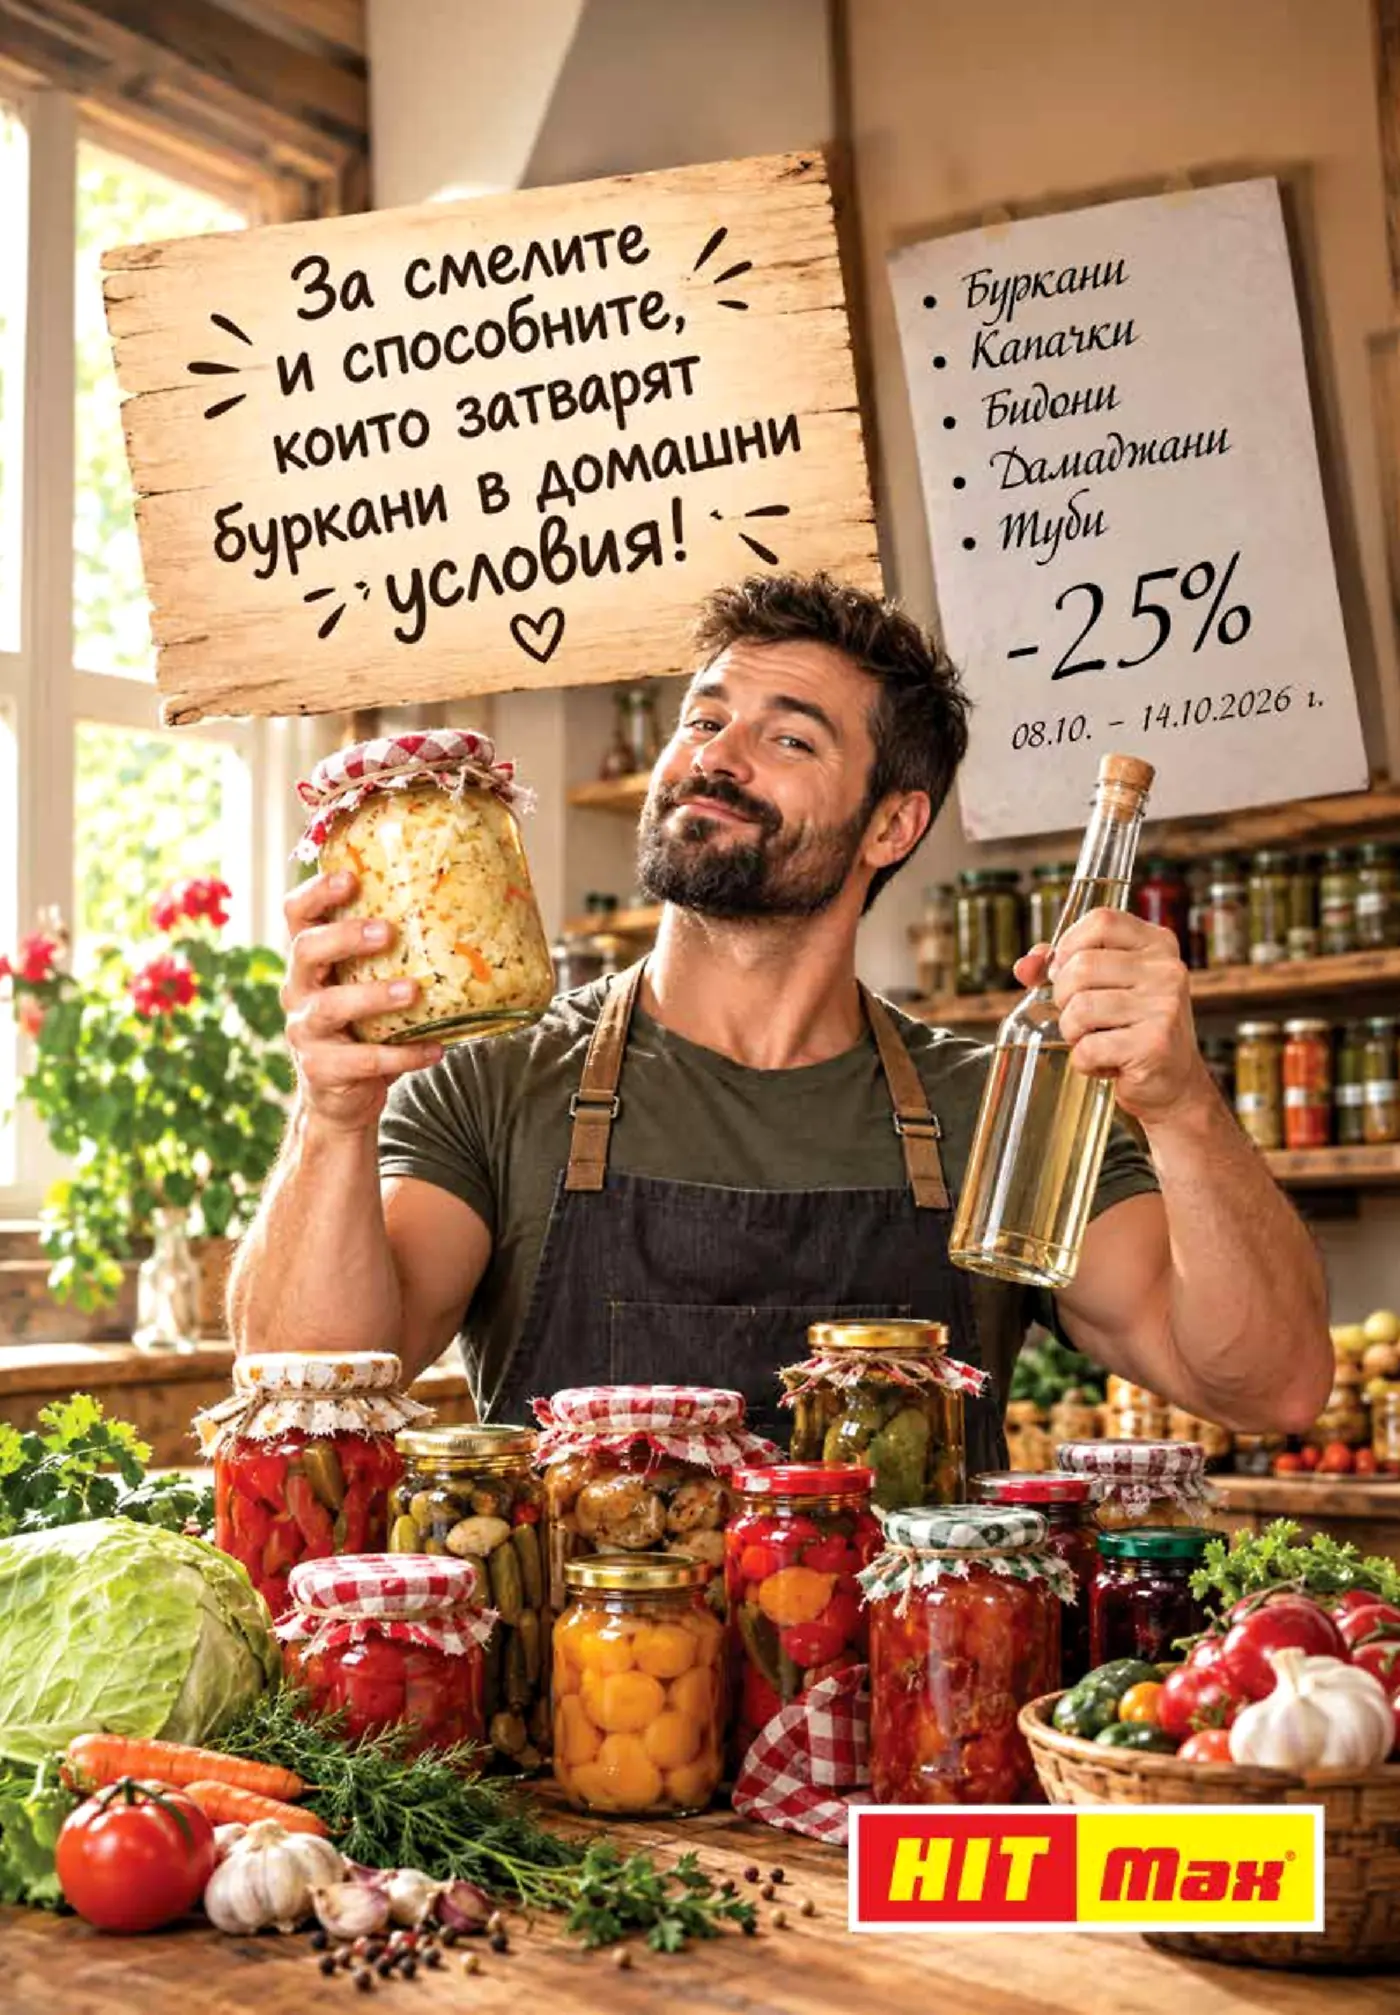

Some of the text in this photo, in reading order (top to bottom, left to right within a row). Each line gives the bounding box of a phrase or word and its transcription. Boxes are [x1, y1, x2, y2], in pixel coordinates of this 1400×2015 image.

[290, 224, 650, 321] За смелите
[961, 258, 1129, 327] Буркани
[277, 291, 685, 396] и способните,
[971, 319, 1138, 370] Капачки
[273, 355, 701, 474] които затварят
[981, 381, 1121, 430] Бидони
[214, 414, 802, 580] буркани в домашни
[989, 427, 1232, 490] Дамаджани
[385, 497, 687, 645] условия!
[999, 487, 1108, 567] Туби
[1006, 550, 1252, 681] -25%
[1011, 714, 1092, 750] 08.10.
[1143, 688, 1291, 733] 14.10.2026
